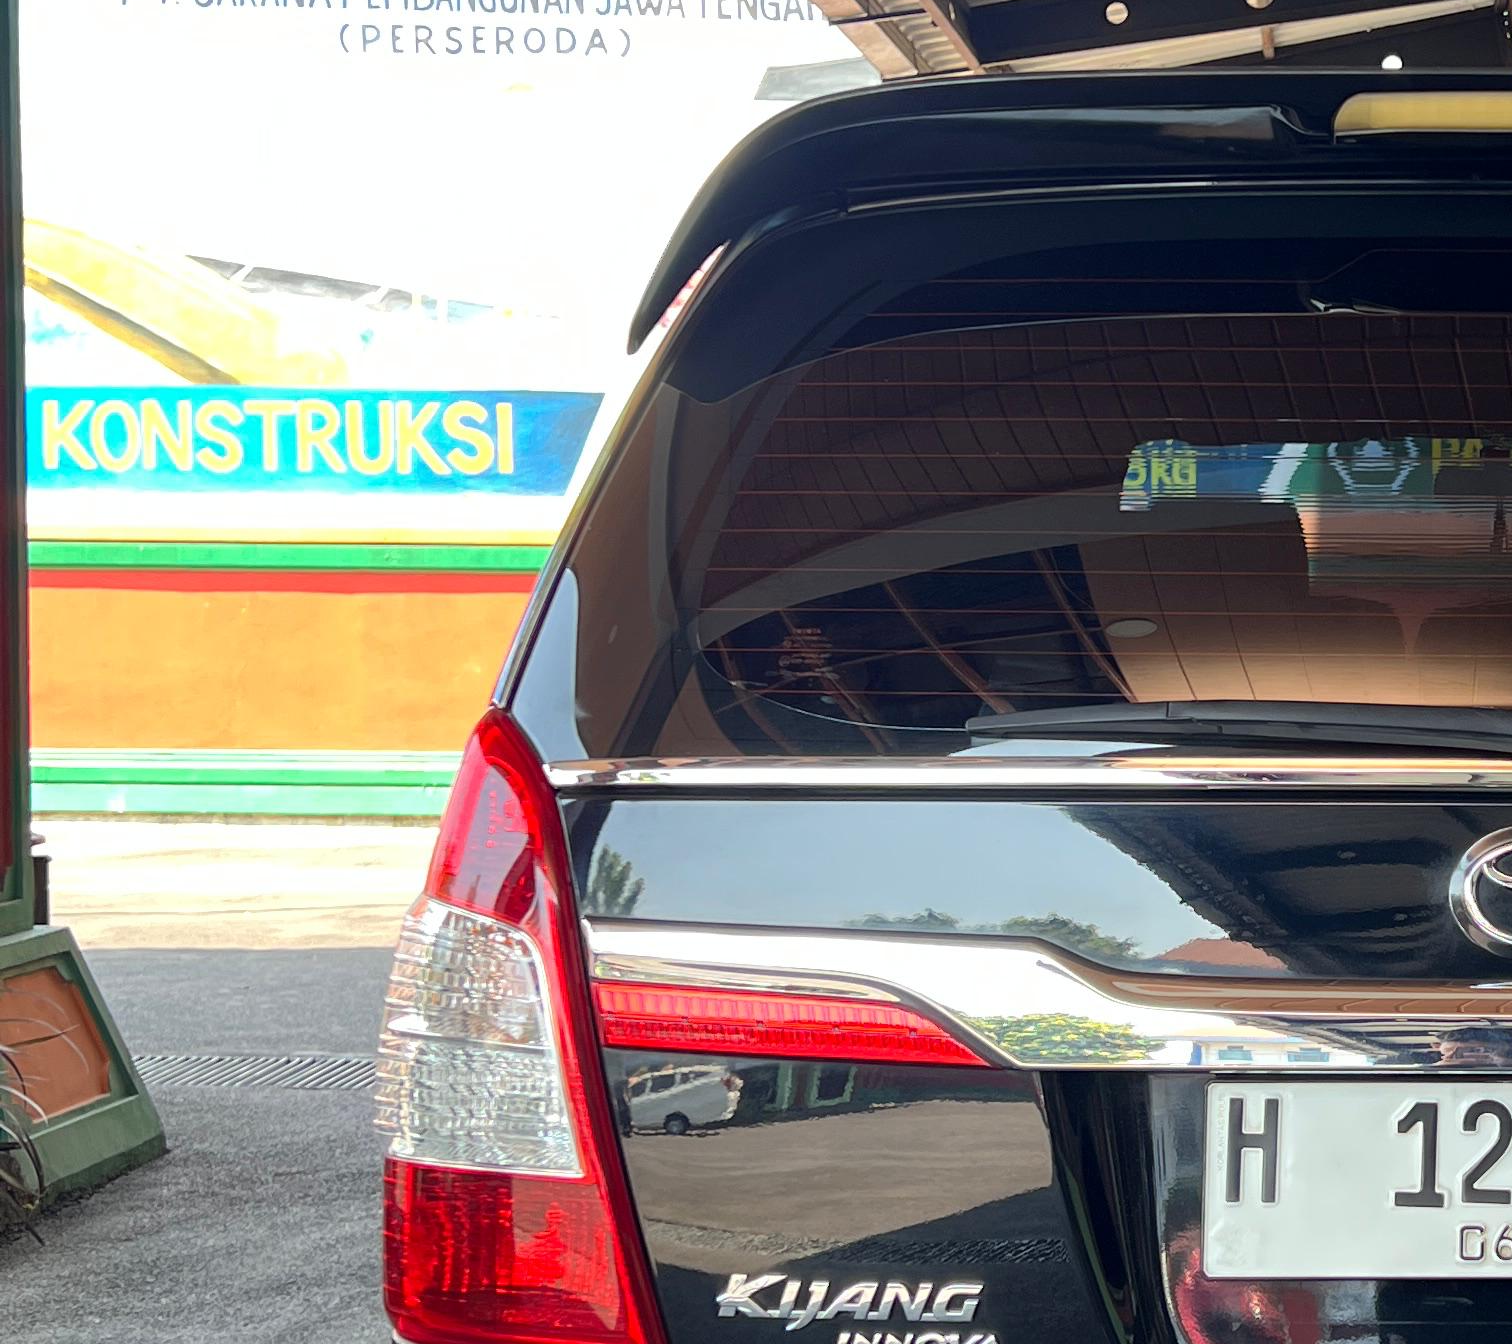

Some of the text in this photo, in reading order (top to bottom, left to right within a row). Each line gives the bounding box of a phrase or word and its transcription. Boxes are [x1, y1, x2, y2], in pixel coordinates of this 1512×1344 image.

[339, 23, 632, 58] (PERSERODA)
[42, 398, 516, 476] KONSTRUKSI
[1225, 1097, 1279, 1203] H
[716, 1273, 984, 1331] KIJANG
